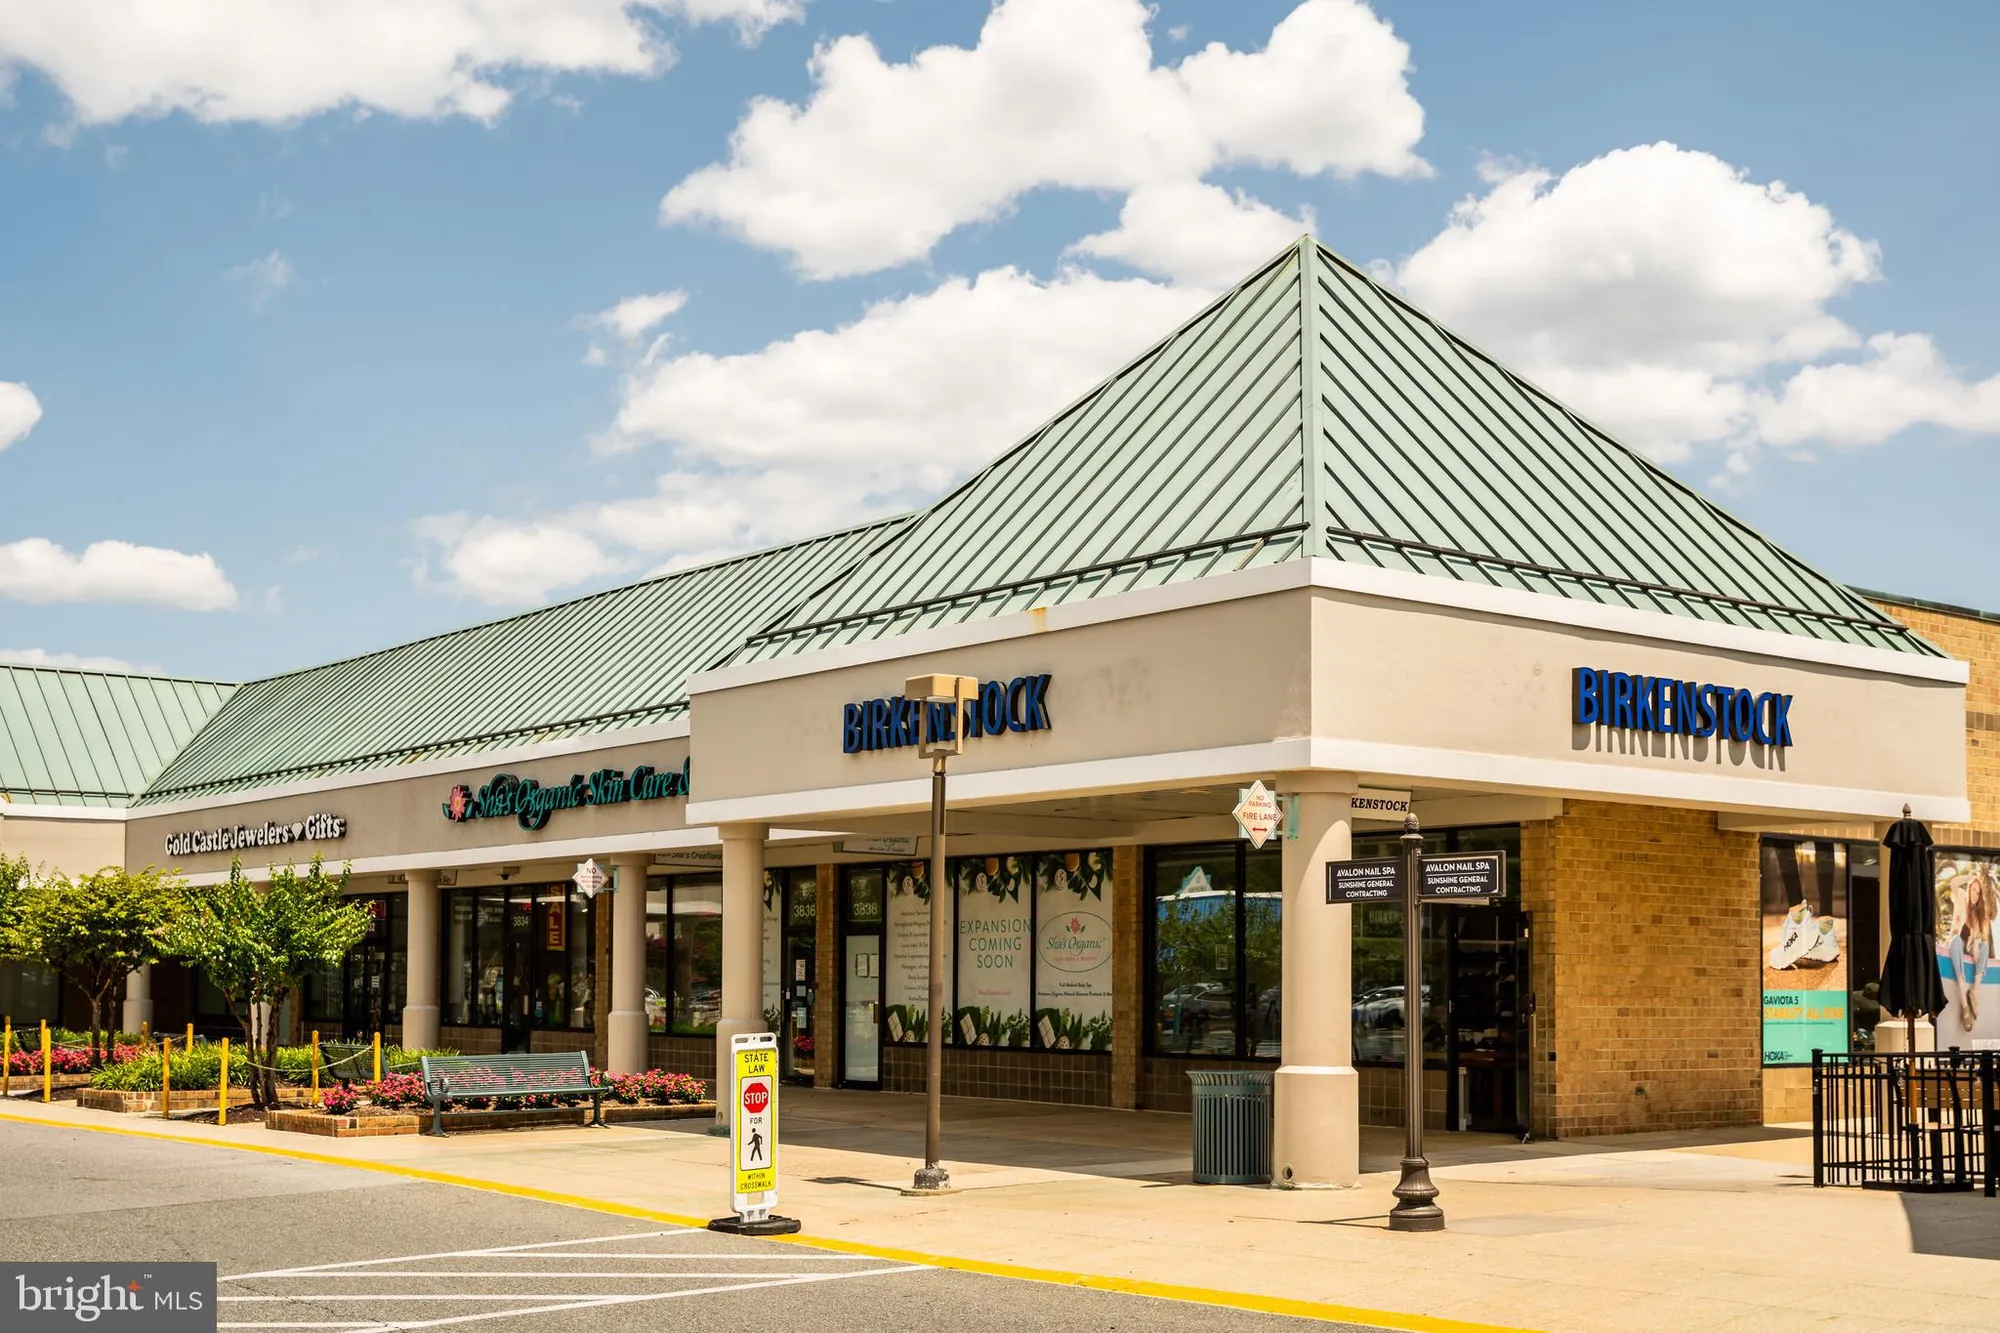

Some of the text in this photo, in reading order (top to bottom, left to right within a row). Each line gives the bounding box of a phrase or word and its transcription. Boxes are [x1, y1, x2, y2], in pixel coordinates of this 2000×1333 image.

[1572, 667, 1794, 747] BIRKENSTOCK
[475, 772, 519, 819] Sha's
[515, 775, 591, 831] Organic
[586, 768, 625, 806] Skin
[630, 764, 681, 800] Care
[1351, 797, 1408, 812] KENSTOCK
[1242, 811, 1277, 821] FIRE LANE
[165, 813, 346, 856] Gold Castle Jewelers Gifts
[1336, 866, 1396, 877] AVALON NAIL SPA
[1425, 861, 1490, 872] AVALON NAIL SPA
[1338, 880, 1394, 889] SUNSHINE GENERAL
[1427, 875, 1488, 885] SUNSHINE GENERAL
[1345, 890, 1388, 898] CONTRACTING
[1435, 886, 1481, 894] CONTRACTING
[793, 904, 816, 918] 3836
[853, 903, 878, 916] 3838
[960, 918, 1031, 935] EXPANSION
[969, 936, 1022, 951] COMING
[1046, 936, 1103, 956] Sha's Organic
[976, 954, 1013, 969] SOON
[1763, 995, 1799, 1005] GAVIOTA 5
[744, 1053, 769, 1063] STATE
[1764, 1051, 1785, 1061] HOKA
[748, 1064, 766, 1074] LAW
[744, 1091, 768, 1105] STOP
[749, 1117, 763, 1125] FOR
[747, 1172, 766, 1180] WITHIN
[740, 1180, 772, 1190] CROSSWALK
